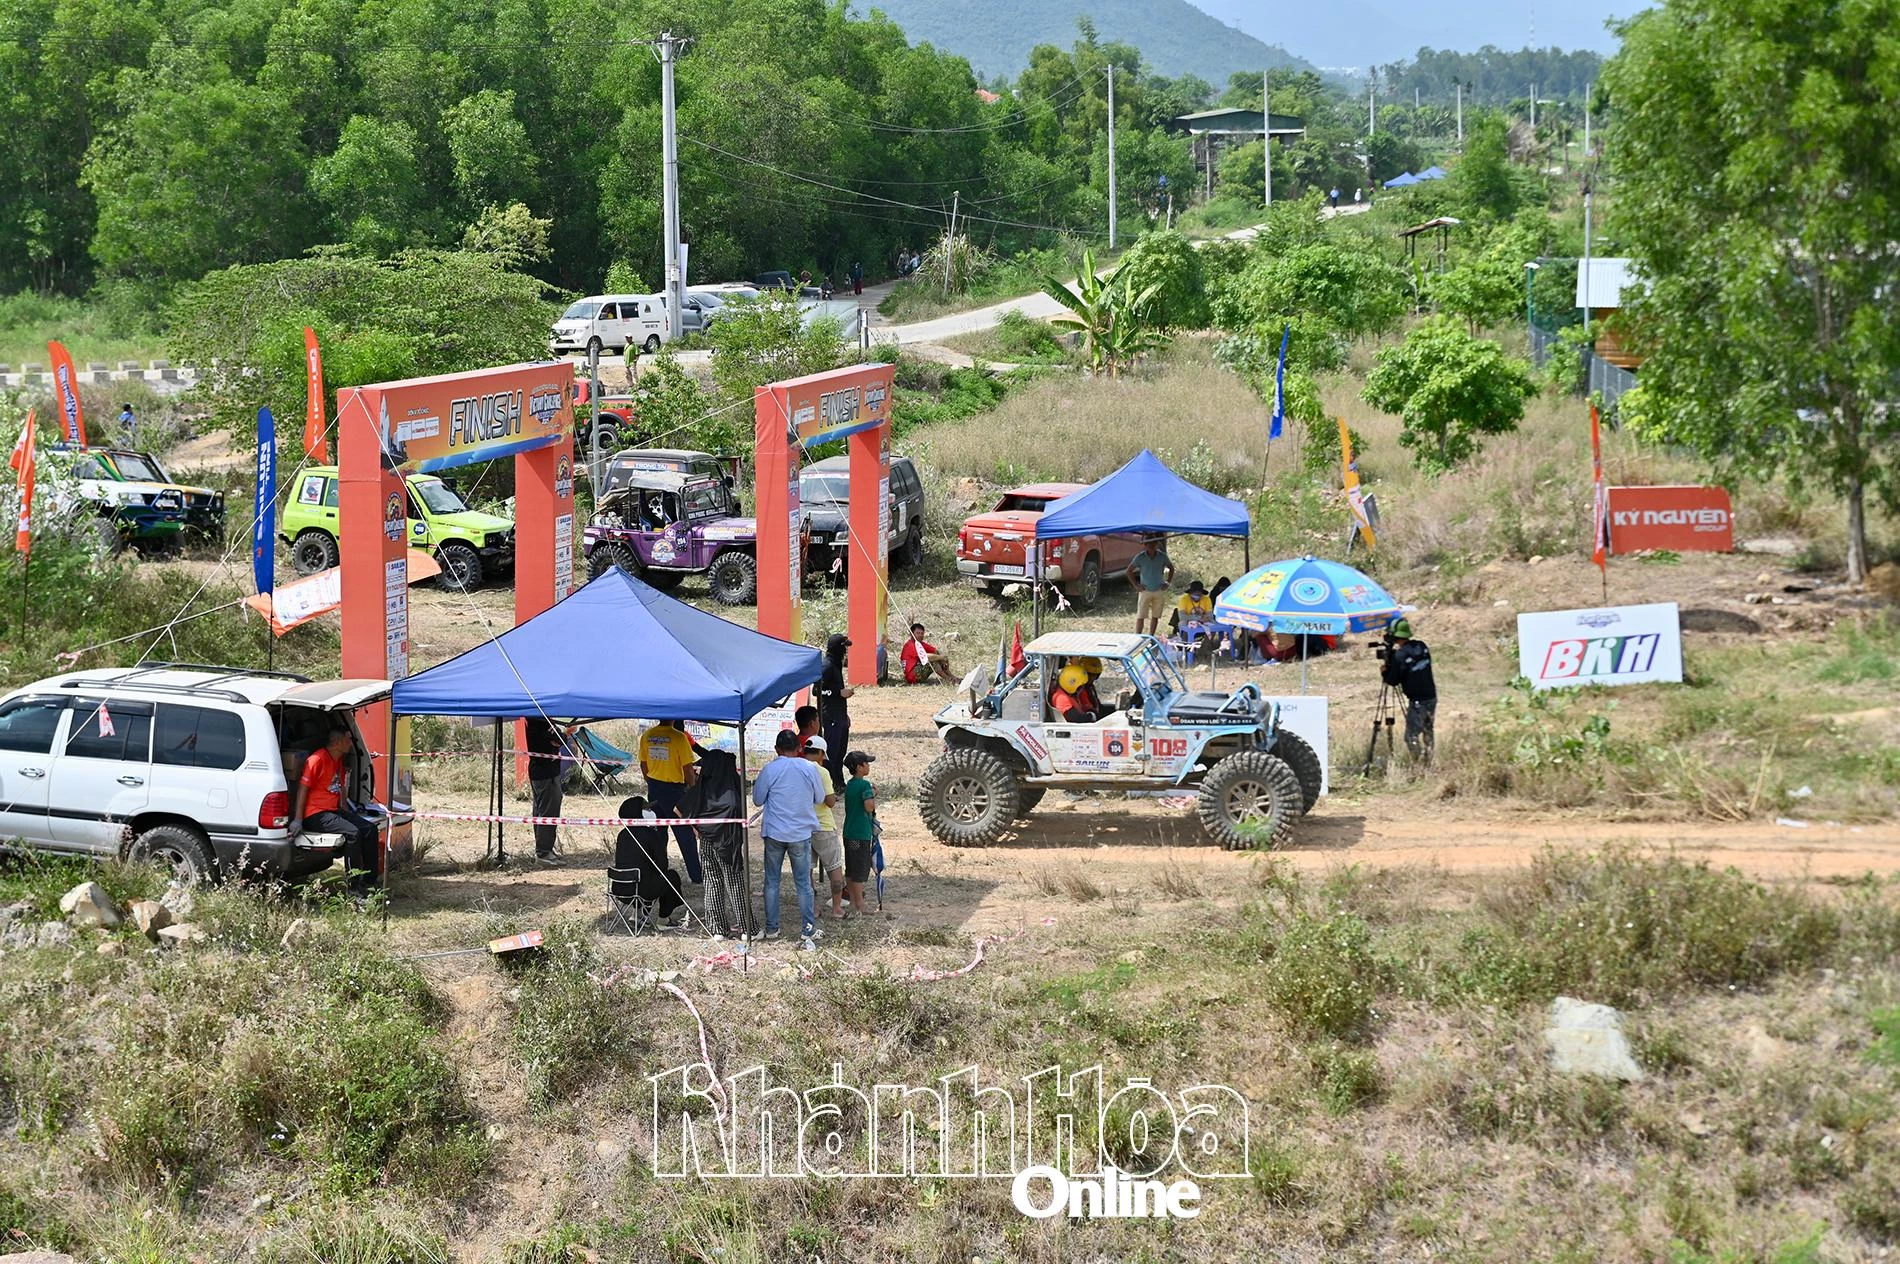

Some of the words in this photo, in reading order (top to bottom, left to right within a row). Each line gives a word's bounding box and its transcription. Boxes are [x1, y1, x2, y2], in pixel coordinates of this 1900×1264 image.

[449, 389, 523, 447] FINISH
[820, 386, 860, 428] FINISH
[1110, 745, 1121, 753] 104
[1149, 738, 1187, 757] 108
